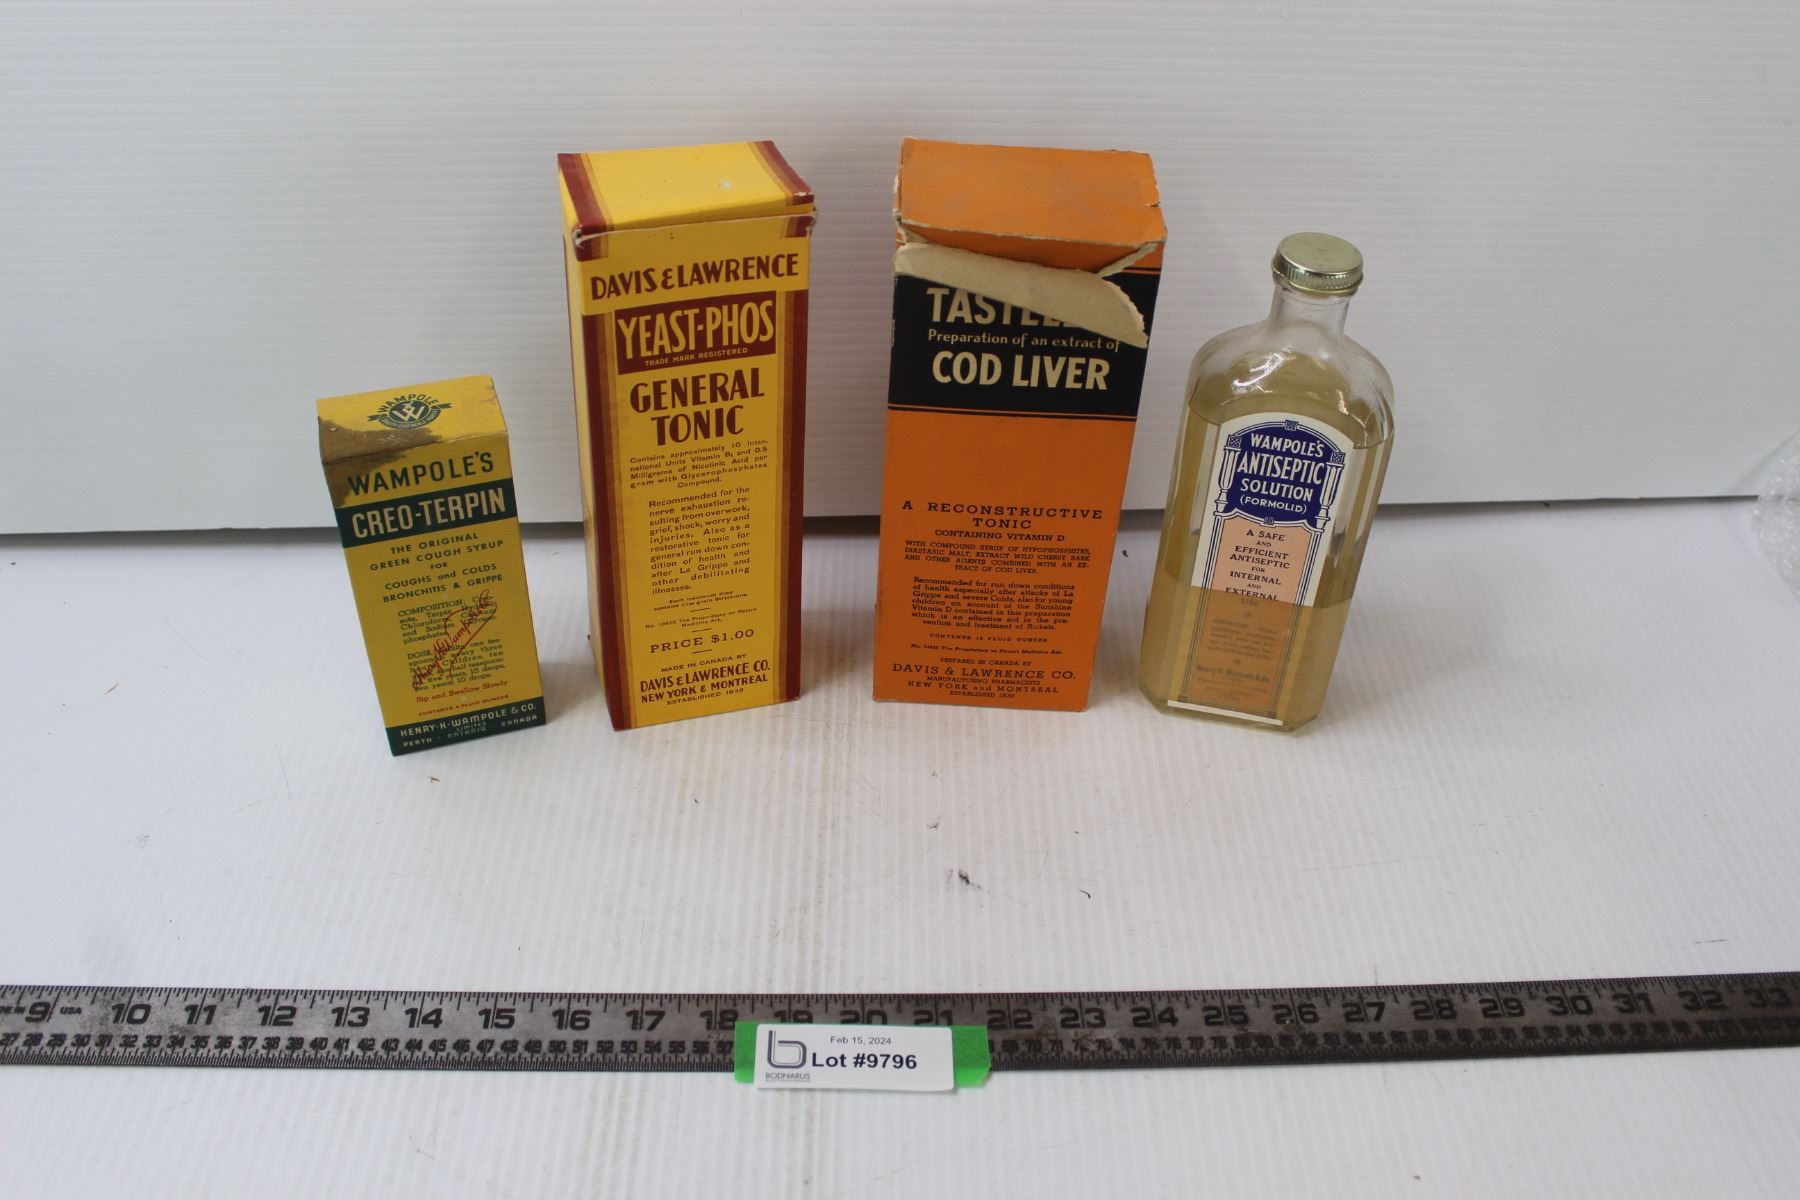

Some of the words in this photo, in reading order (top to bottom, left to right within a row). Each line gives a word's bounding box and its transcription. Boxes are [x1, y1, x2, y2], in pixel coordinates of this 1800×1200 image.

[590, 267, 657, 300] DAVIS
[678, 253, 798, 287] LAWRENCE
[617, 300, 773, 359] YEAST-PHOS
[928, 328, 1007, 344] Preparation
[1011, 333, 1028, 347] of
[1051, 336, 1101, 348] extract
[645, 357, 668, 366] TRADE
[698, 347, 747, 358] REGISTERED
[932, 350, 1001, 384] COD
[1012, 354, 1109, 389] LIVER
[629, 367, 764, 413] GENERAL
[377, 393, 439, 413] WAMPOLE
[650, 405, 743, 445] TONIC
[629, 454, 665, 463] Contains
[670, 444, 724, 458] approximately
[1251, 433, 1326, 457] WAMPOLE'S
[630, 461, 660, 471] national
[690, 453, 720, 462] Vitamin
[630, 469, 672, 479] Milligrams
[691, 460, 725, 470] Nicotinic
[731, 456, 748, 464] Acid
[1236, 450, 1324, 484] ANTISEPTIC
[345, 451, 493, 495] WAMPOLE'S
[630, 480, 653, 488] gram
[657, 475, 677, 483] with
[680, 463, 767, 479] Glycerophosphates
[677, 476, 721, 488] Compound.
[648, 491, 716, 507] Recommended
[1240, 478, 1313, 501] SOLUTION
[352, 487, 505, 538] CREO-TERPIN
[649, 508, 674, 516] nerve
[680, 499, 730, 511] exhaustion
[902, 500, 912, 509] A
[927, 502, 1102, 519] RECONSTRUCTIVE
[1239, 494, 1306, 514] (FORMOLID)
[649, 516, 680, 525] sulting
[682, 512, 703, 520] from
[705, 505, 749, 516] overwork,
[649, 525, 672, 536] grief,
[674, 521, 702, 531] shock,
[704, 517, 731, 525] worry
[732, 513, 749, 521] and
[972, 517, 1031, 529] TONIC
[390, 544, 411, 554] THE
[418, 532, 478, 549] ORIGINAL
[650, 532, 693, 544] injuries.
[703, 527, 725, 535] Also
[650, 540, 698, 552] restorative
[708, 535, 729, 543] tonic
[934, 529, 1002, 539] CONTAINING
[1007, 533, 1052, 541] VITAMIN
[1258, 530, 1284, 541] SAFE
[370, 557, 409, 570] GREEN
[416, 547, 460, 561] COUGH
[466, 539, 503, 552] SYRUP
[650, 550, 683, 562] general
[704, 544, 728, 552] down
[650, 561, 676, 569] dition
[698, 553, 725, 562] health
[733, 548, 749, 557] and
[1229, 553, 1289, 568] ANTISEPTIC
[1234, 545, 1288, 559] EFFICIENT
[384, 575, 431, 590] COUGHS
[437, 570, 456, 579] and
[462, 563, 496, 575] COLDS
[651, 570, 672, 578] after
[697, 562, 727, 570] Grippe
[733, 557, 749, 565] and
[651, 577, 679, 586] other
[690, 566, 749, 580] debilitating
[1229, 570, 1280, 585] INTERNAL
[382, 584, 446, 602] BRONCHITIS
[467, 574, 502, 585] GRIPPE
[652, 584, 691, 594] illnesses.
[1225, 586, 1279, 601] EXTERNAL
[650, 636, 702, 653] PRICE
[711, 628, 753, 643] $1.00
[661, 664, 683, 672] MADE
[699, 656, 733, 665] CANADA
[892, 663, 938, 673] DAVIS
[944, 666, 954, 675] &
[961, 668, 1044, 678] LAWRENCE
[1051, 670, 1076, 679] CO.
[640, 675, 673, 692] DAVIS
[685, 662, 748, 684] LAWRENCE
[753, 659, 770, 672] CO.
[431, 691, 446, 699] and
[448, 687, 479, 696] Swallow
[482, 679, 507, 689] Slowly
[641, 691, 664, 703] NEW
[666, 685, 696, 698] YORK
[710, 673, 767, 690] MONTREAL
[667, 691, 721, 705] ESTABLISHED
[996, 685, 1058, 693] MONTREAL
[403, 737, 431, 746] PERTH
[501, 714, 537, 726] CANADA
[25, 1002, 51, 1022] 9
[112, 1003, 151, 1024] 10
[184, 1004, 217, 1024] 11
[258, 1004, 297, 1026] 12
[331, 1006, 370, 1027] 13
[405, 1007, 442, 1028] 14
[478, 1008, 516, 1029] 15
[552, 1010, 591, 1030] 16
[627, 1011, 666, 1030] 17
[700, 1011, 738, 1030] 18
[987, 1009, 1033, 1029] 22
[1060, 1007, 1106, 1029] 23
[1131, 1006, 1179, 1027] 24
[1203, 1005, 1249, 1026] 25
[1272, 1004, 1319, 1024] 26
[1342, 1003, 1385, 1022] 27
[1411, 1001, 1457, 1020] 28
[1479, 998, 1525, 1018] 29
[1546, 996, 1593, 1015] 30
[1612, 993, 1656, 1014] 31
[1678, 990, 1728, 1012] 32
[1743, 988, 1792, 1008] 33
[831, 1036, 847, 1045] Feb
[852, 1037, 865, 1046] 15,
[868, 1037, 891, 1045] 2024
[812, 1053, 846, 1068] Lot
[854, 1054, 917, 1069] #9796
